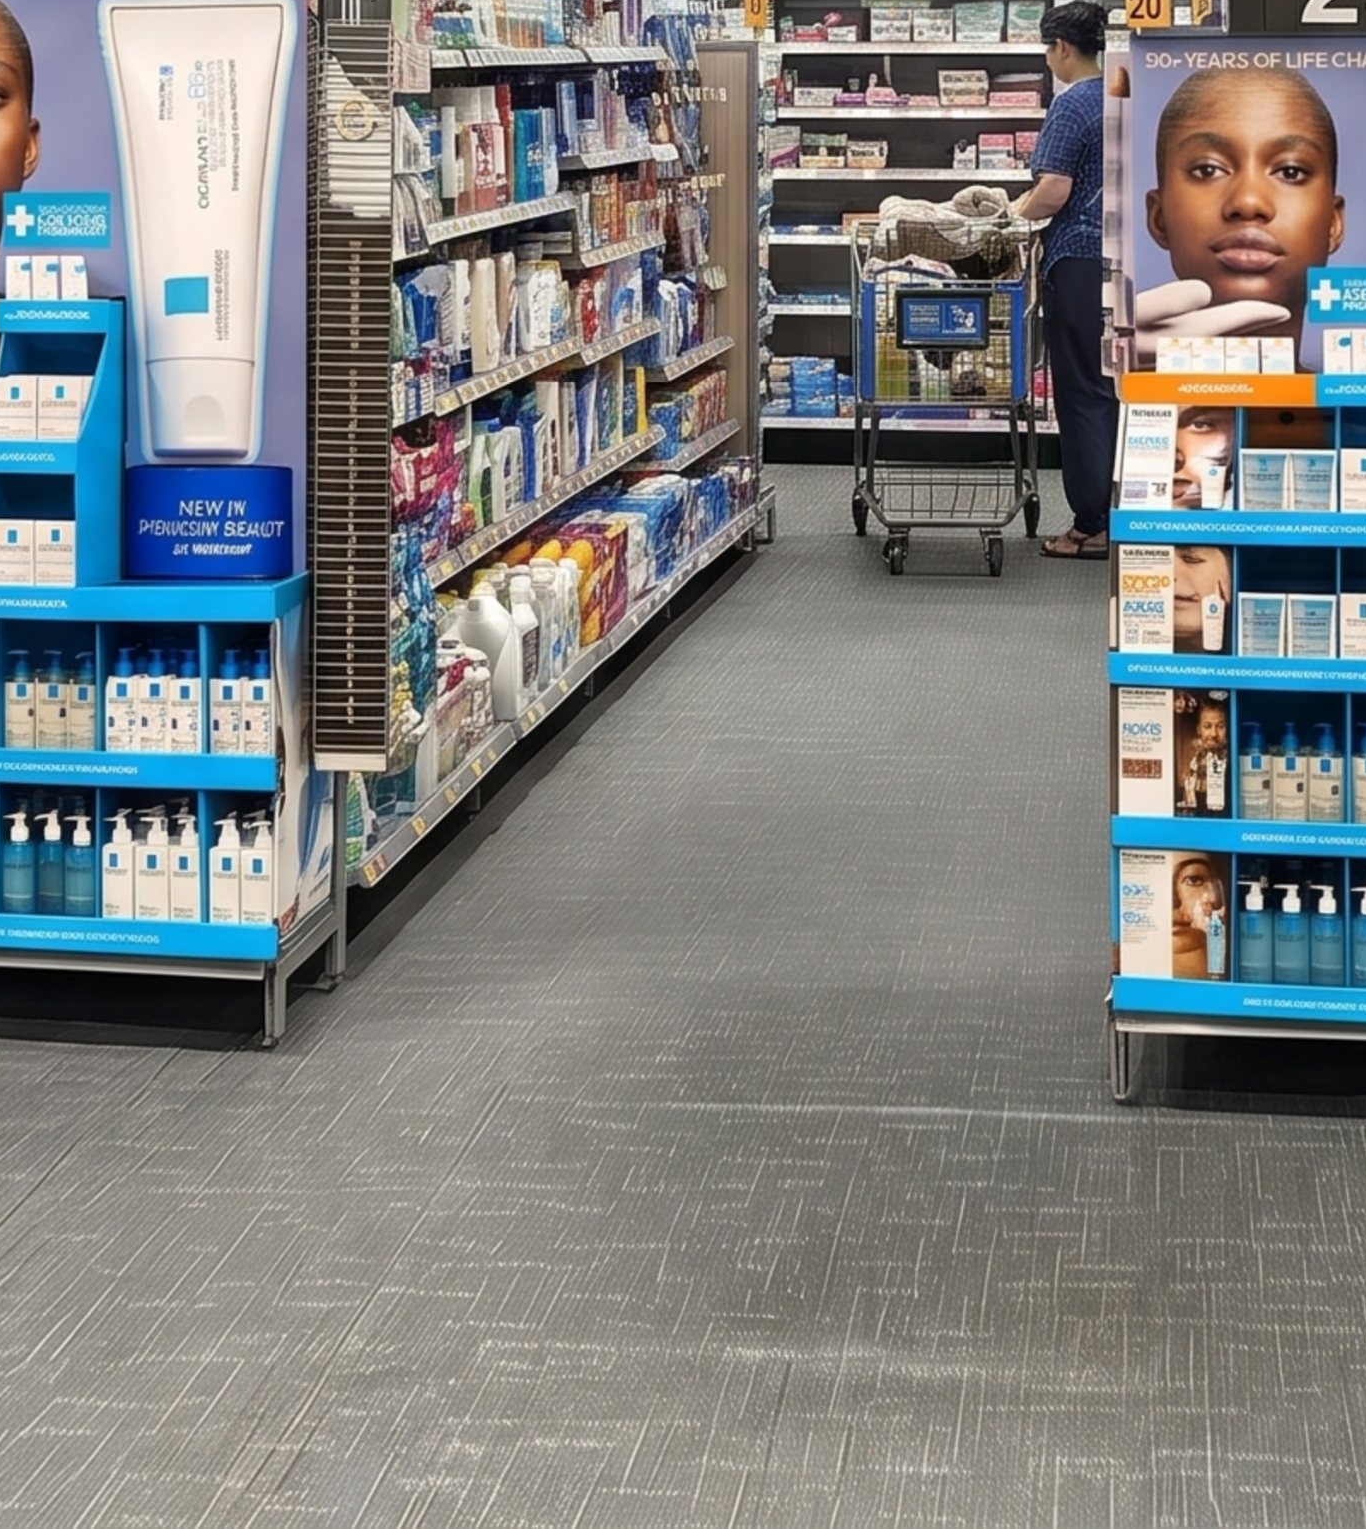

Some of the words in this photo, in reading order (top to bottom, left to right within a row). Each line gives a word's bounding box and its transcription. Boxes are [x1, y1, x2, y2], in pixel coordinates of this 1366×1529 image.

[1184, 52, 1249, 69] YEARS
[1253, 52, 1281, 68] OF
[1285, 52, 1329, 69] LIFE
